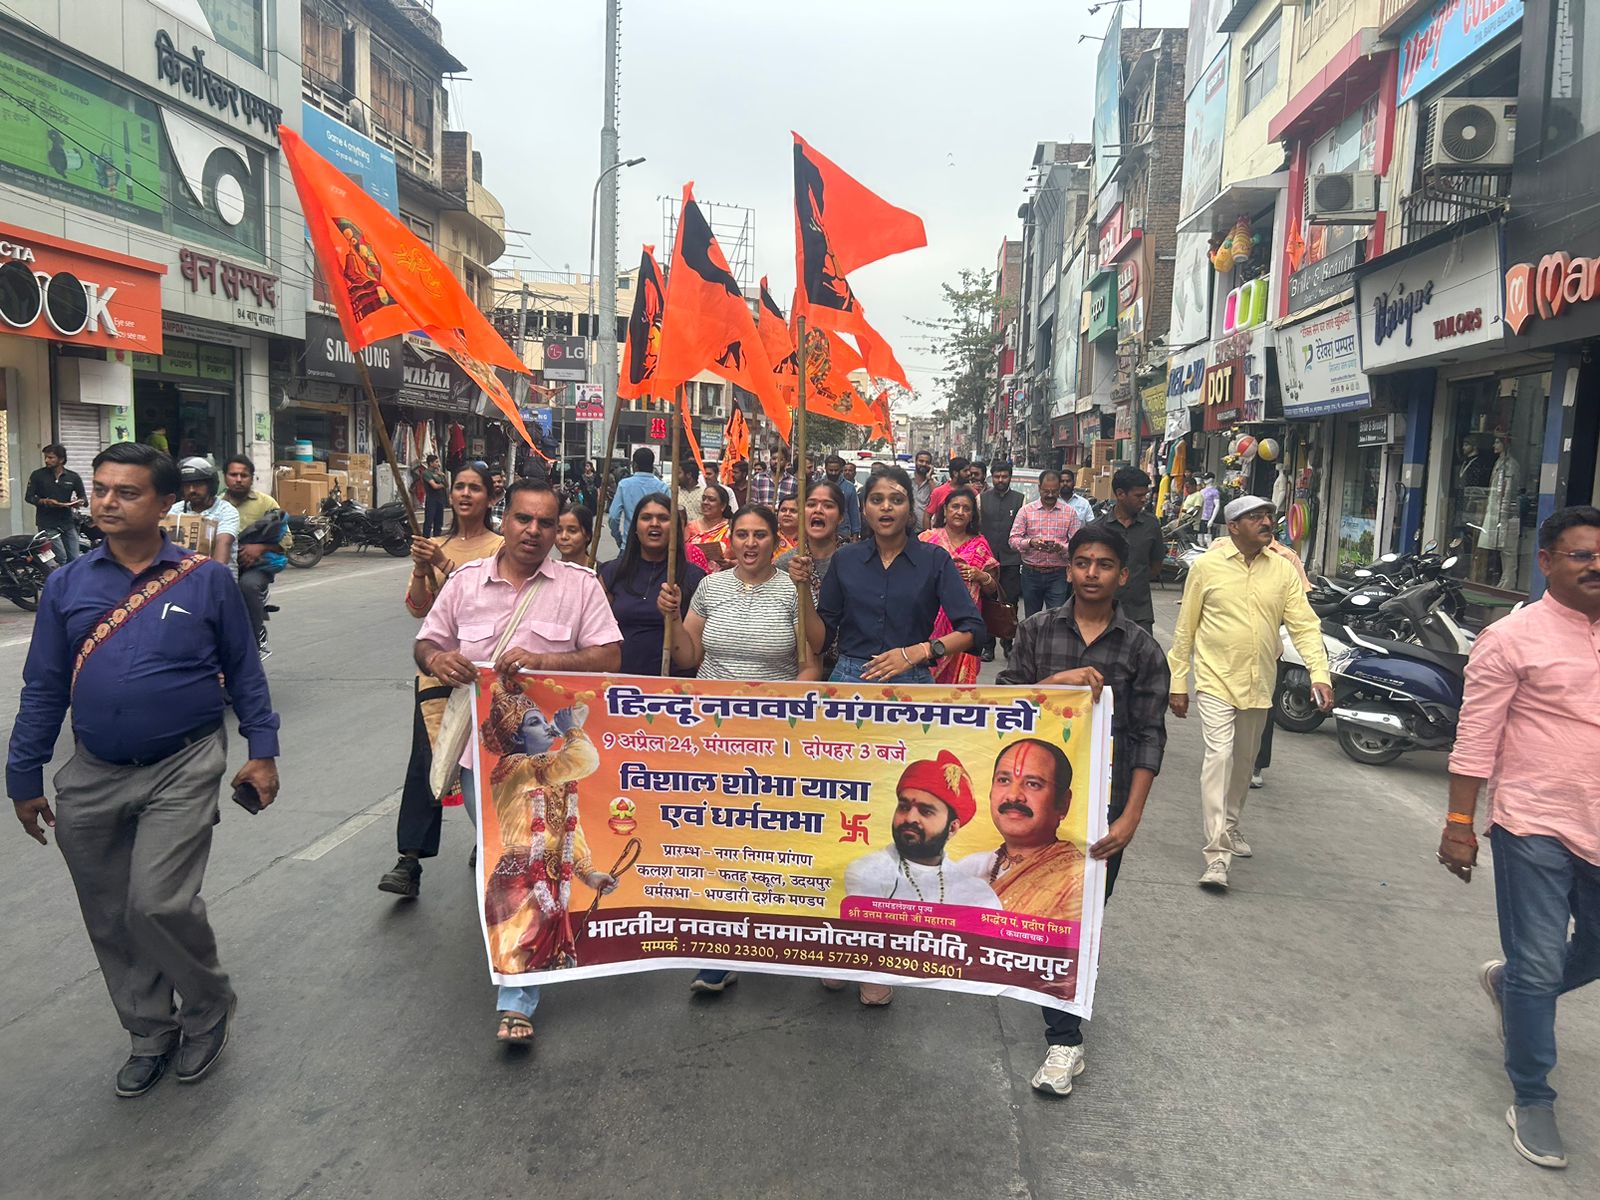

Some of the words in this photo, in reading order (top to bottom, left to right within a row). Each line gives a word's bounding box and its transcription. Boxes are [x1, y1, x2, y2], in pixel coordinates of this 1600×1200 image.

[180, 248, 219, 293] धन
[1433, 308, 1482, 341] TAILORS
[566, 346, 584, 359] LG
[1207, 366, 1232, 406] DOT
[607, 686, 701, 725] हिन्दू
[701, 691, 817, 721] नववर्ष
[823, 694, 989, 727] मंगलमय
[995, 700, 1038, 731] हो
[604, 733, 616, 749] 9
[620, 731, 665, 752] अप्रैल
[669, 739, 698, 756] 24,
[703, 736, 774, 756] मंगलवार
[802, 736, 855, 761] दोपहर
[859, 746, 871, 759] 3
[875, 741, 906, 762] बजे
[620, 763, 716, 793] विशाल
[721, 767, 796, 797] शोभा
[801, 779, 871, 802] यात्रा
[660, 800, 709, 829] एवं
[711, 802, 824, 833] धर्मसभा
[662, 844, 701, 858] प्रारम्भ
[714, 848, 739, 862] नगर
[742, 847, 776, 863] निगम
[777, 849, 814, 867] प्रांगण
[636, 864, 673, 878] कलश
[676, 866, 705, 879] यात्रा
[718, 868, 747, 883] फतह
[751, 871, 786, 888] स्कूल,
[790, 875, 832, 889] उदयपुर
[644, 884, 690, 899] धर्मसभा
[704, 886, 749, 903] भण्डारी
[752, 889, 785, 905] दर्शक
[788, 894, 826, 908] मण्डप
[917, 904, 933, 914] पूज्य
[848, 908, 861, 918] श्री
[863, 909, 883, 920] उत्तम
[884, 910, 908, 922] स्वामी
[909, 912, 921, 923] जी
[924, 916, 957, 927] महाराज
[980, 913, 1007, 926] श्रद्धेय
[1021, 917, 1045, 933] प्रदीप
[1047, 920, 1072, 935] मिश्रा
[587, 910, 675, 939] भारतीय
[679, 917, 750, 938] नववर्ष
[754, 920, 886, 949] समाजोत्सव
[890, 930, 973, 966] समिति,
[979, 945, 1073, 981] उदयपुर
[690, 942, 731, 955] 77280
[734, 943, 779, 960] 23300,
[783, 948, 824, 962] 97844
[828, 952, 873, 967] 57739,
[877, 956, 919, 972] 98290
[922, 962, 963, 979] 85401
